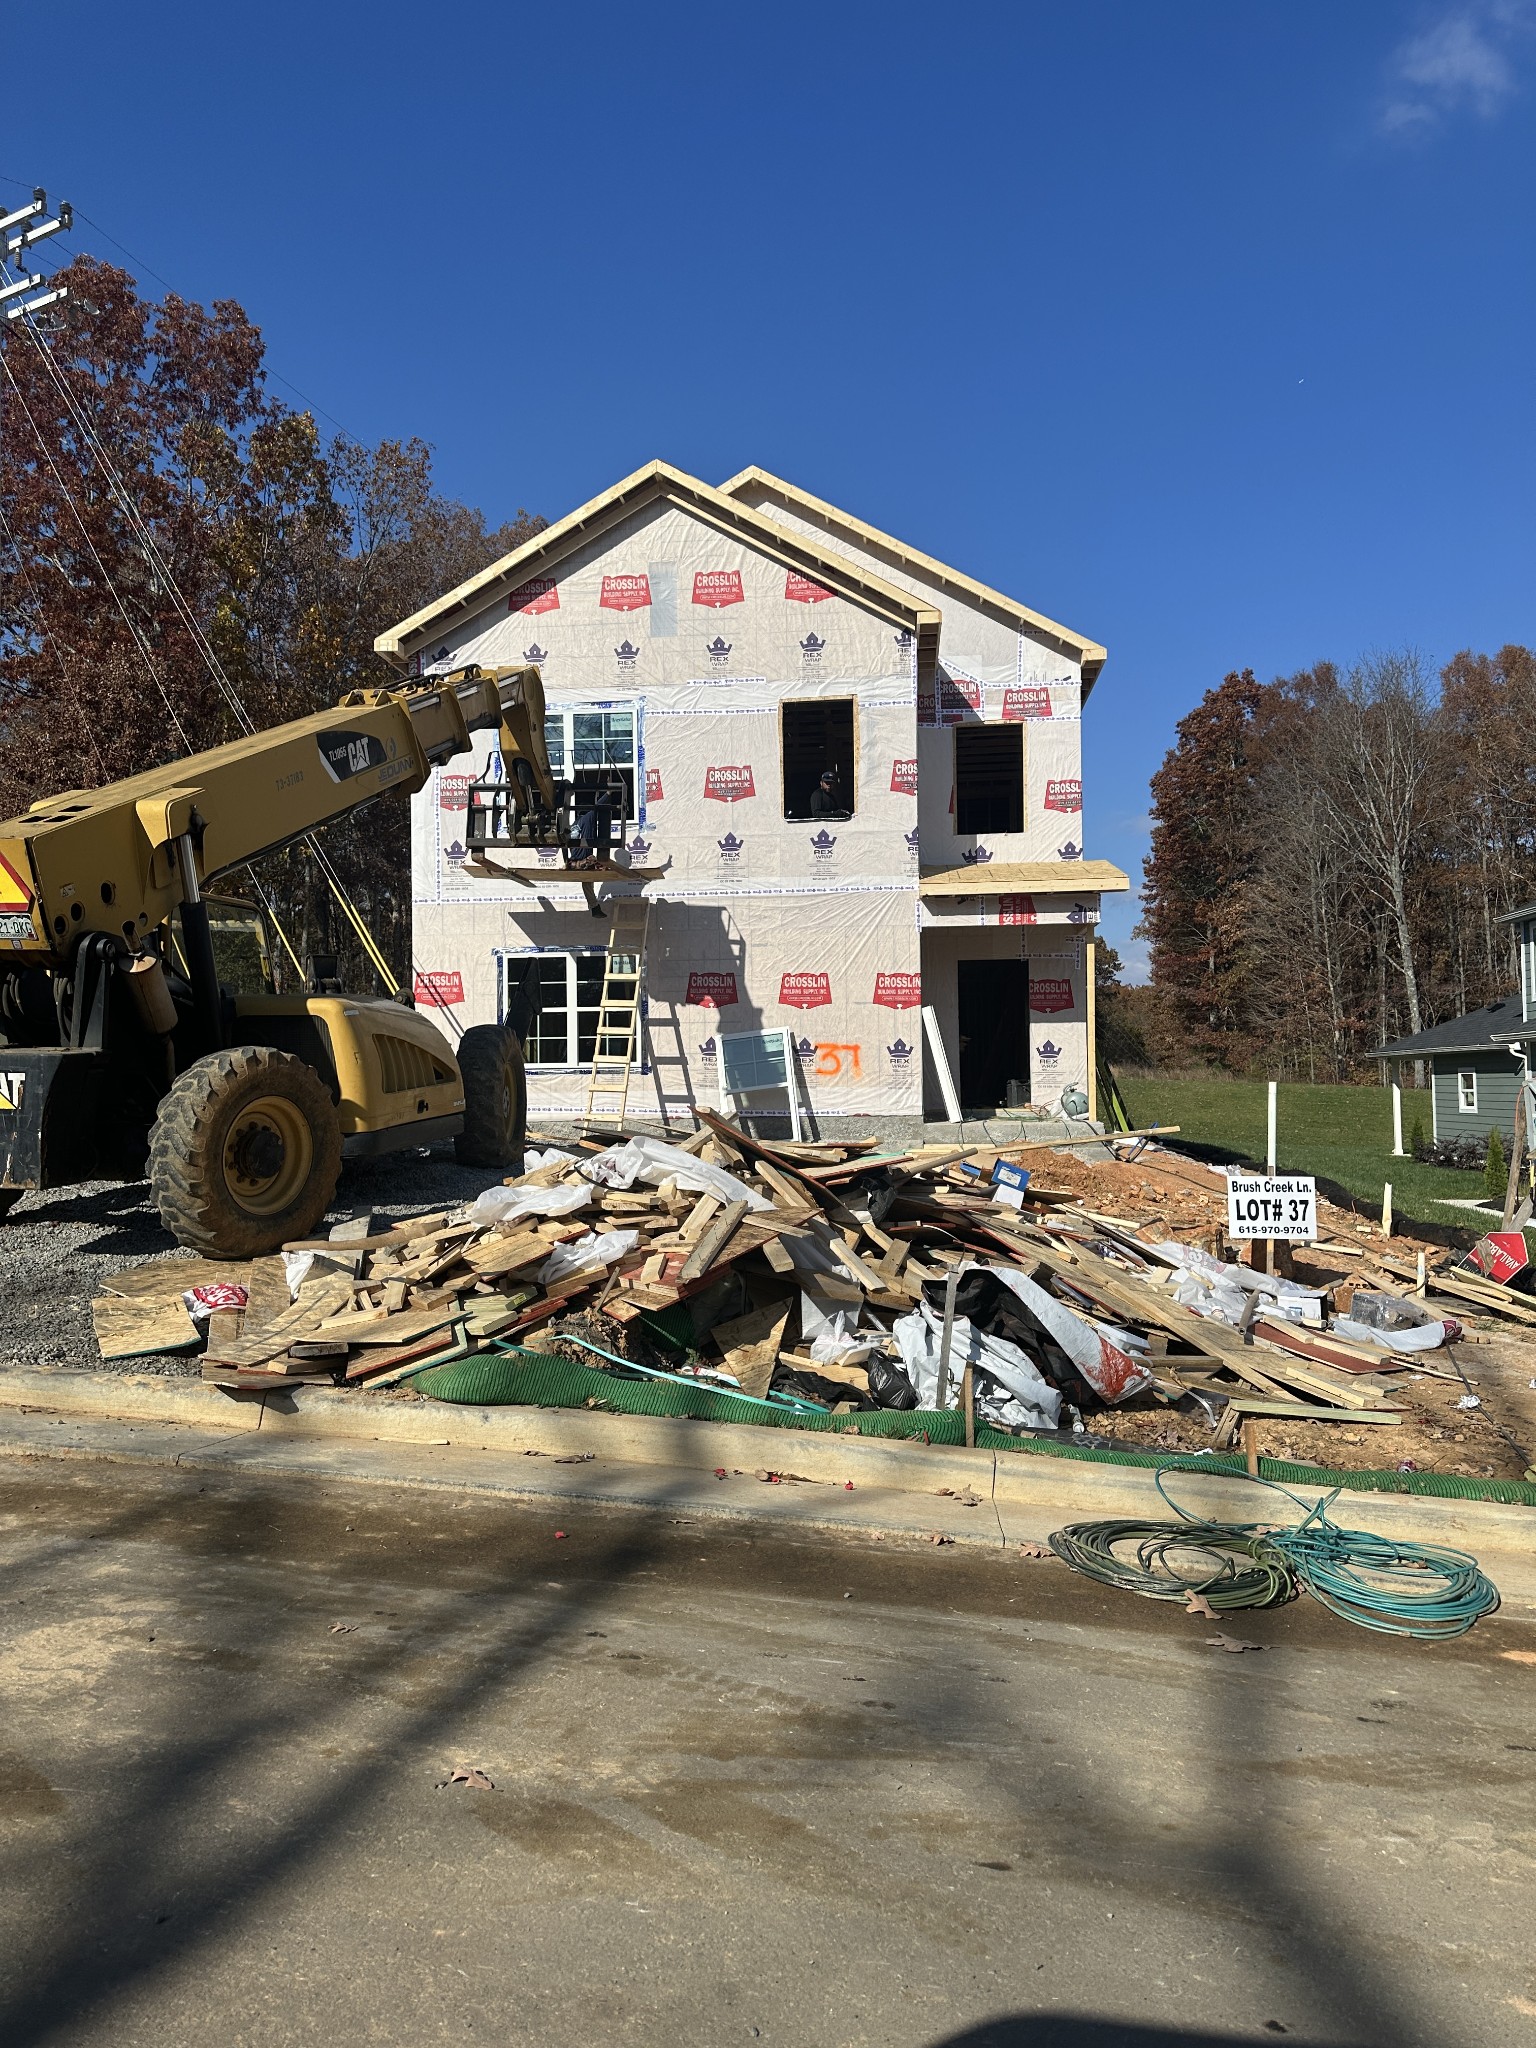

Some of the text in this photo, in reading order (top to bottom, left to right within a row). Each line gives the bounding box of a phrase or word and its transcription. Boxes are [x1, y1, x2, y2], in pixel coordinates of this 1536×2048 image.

[604, 578, 646, 590] CROSSLIN
[696, 574, 738, 586] CROSSLIN
[1007, 691, 1046, 702] CROSSLIN
[348, 737, 370, 772] CAT
[710, 770, 750, 781] CROSSLIN
[418, 975, 459, 986] CROSSLIN
[692, 976, 732, 986] CROSSLIN
[785, 977, 826, 987] CROSSLIN
[879, 977, 921, 987] CROSSLIN
[1030, 983, 1068, 993] CROSSLIN
[1232, 1181, 1311, 1192] Brush Creek Ln.
[1236, 1199, 1309, 1221] LOT# 37
